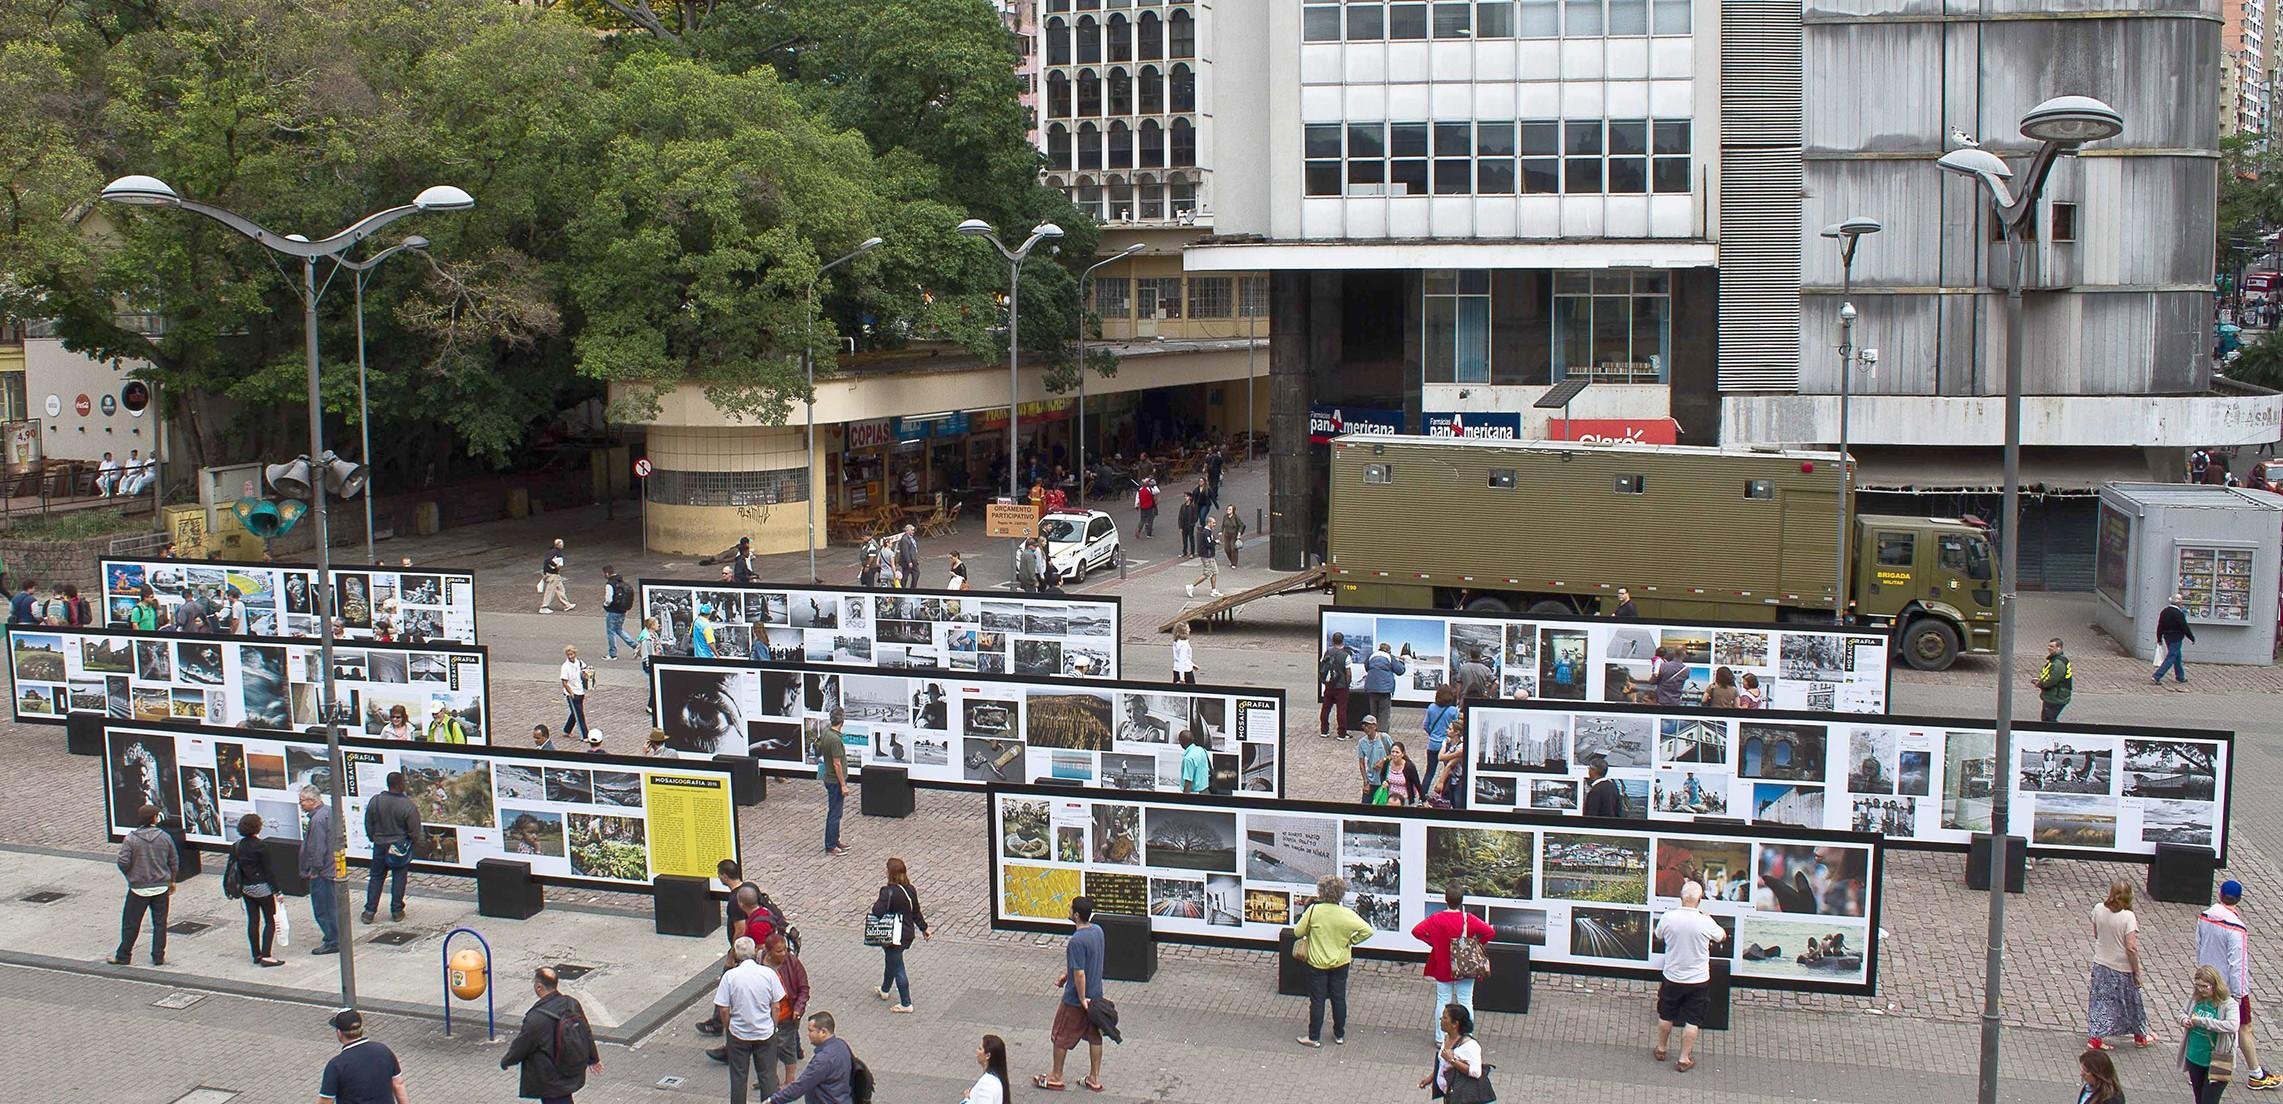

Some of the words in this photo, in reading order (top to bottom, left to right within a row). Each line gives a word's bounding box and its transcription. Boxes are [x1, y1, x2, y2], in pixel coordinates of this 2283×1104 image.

[1310, 409, 1395, 434] panAmericana
[1430, 414, 1513, 439] panAmericana
[851, 422, 890, 446] CÓPIAS
[994, 505, 1032, 513] ORÇAMENTO
[991, 512, 1035, 520] PARTICIPATIVO
[1877, 571, 1911, 580] BRIGADA
[655, 778, 706, 786] MOSAICOGRAFIA
